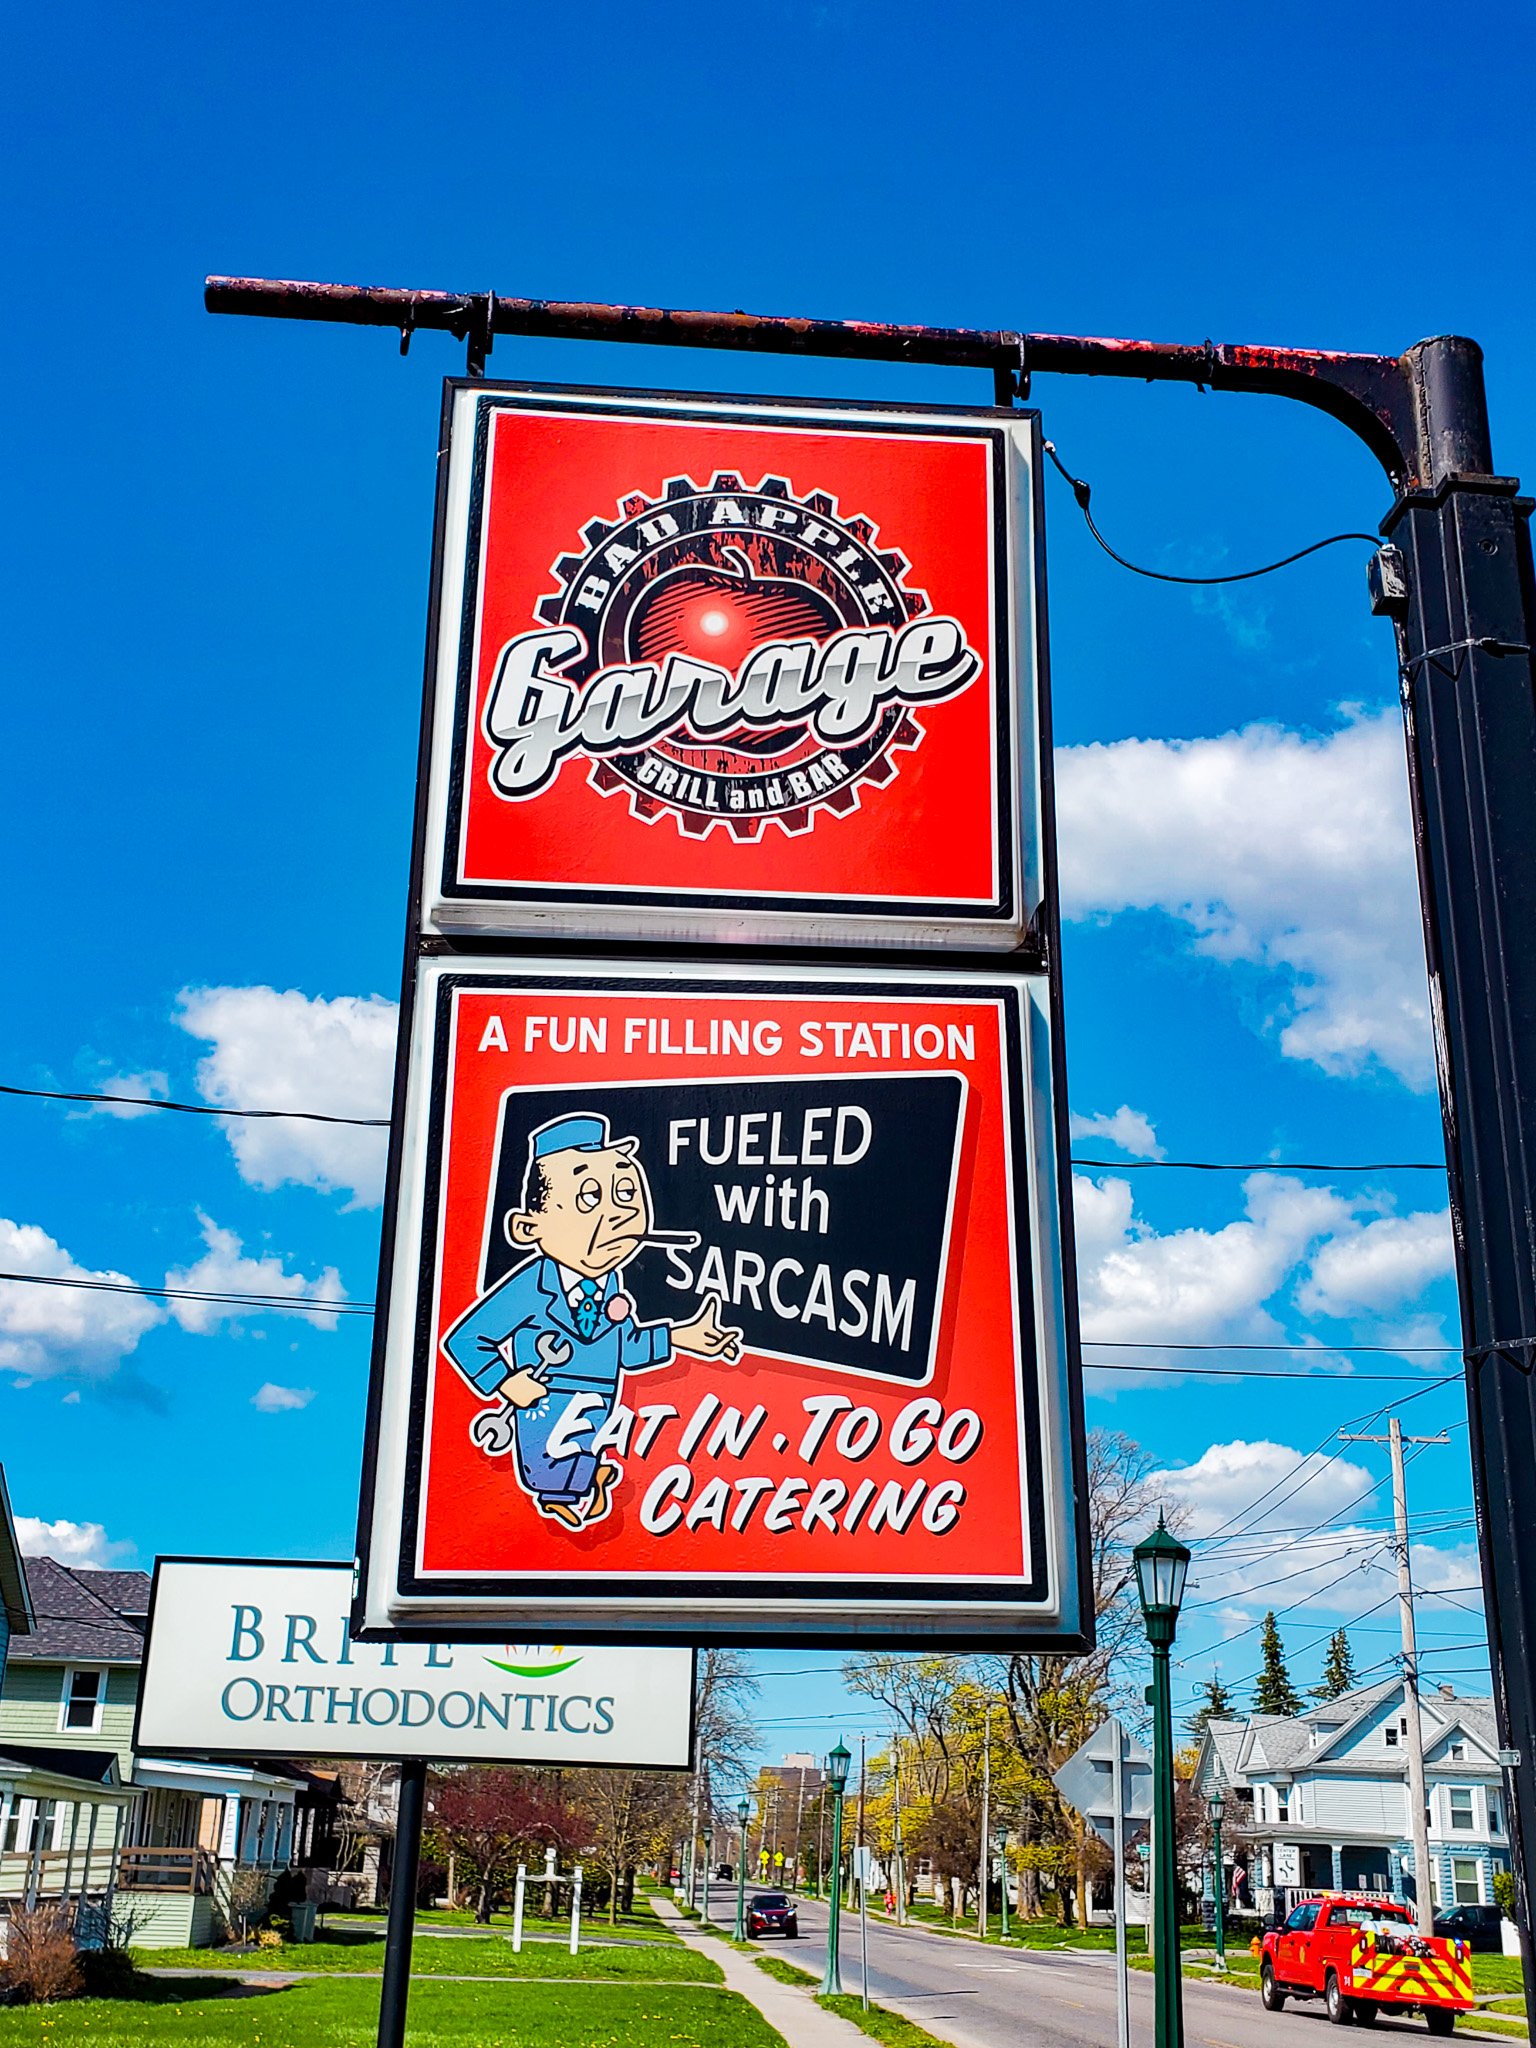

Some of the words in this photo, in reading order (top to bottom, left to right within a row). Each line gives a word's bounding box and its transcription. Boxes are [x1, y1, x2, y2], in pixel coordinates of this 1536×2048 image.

[575, 513, 681, 615] BAD
[708, 499, 895, 615] APPLE
[485, 619, 979, 796] Garage
[636, 757, 719, 809] GRILL
[729, 778, 784, 809] and
[787, 752, 850, 800] BAR
[477, 1015, 509, 1052] A
[524, 1016, 607, 1053] FUN
[624, 1018, 783, 1056] FILLING
[799, 1022, 976, 1061] STATION
[668, 1105, 873, 1166] FUELED
[713, 1173, 830, 1234] with
[665, 1244, 917, 1352] SARCASM
[546, 1392, 679, 1460] EAT
[677, 1392, 768, 1463] IN
[798, 1394, 882, 1465] TO
[889, 1397, 984, 1466] GO
[639, 1463, 967, 1537] CATERING
[221, 1676, 615, 1734] ORTHODONTICS
